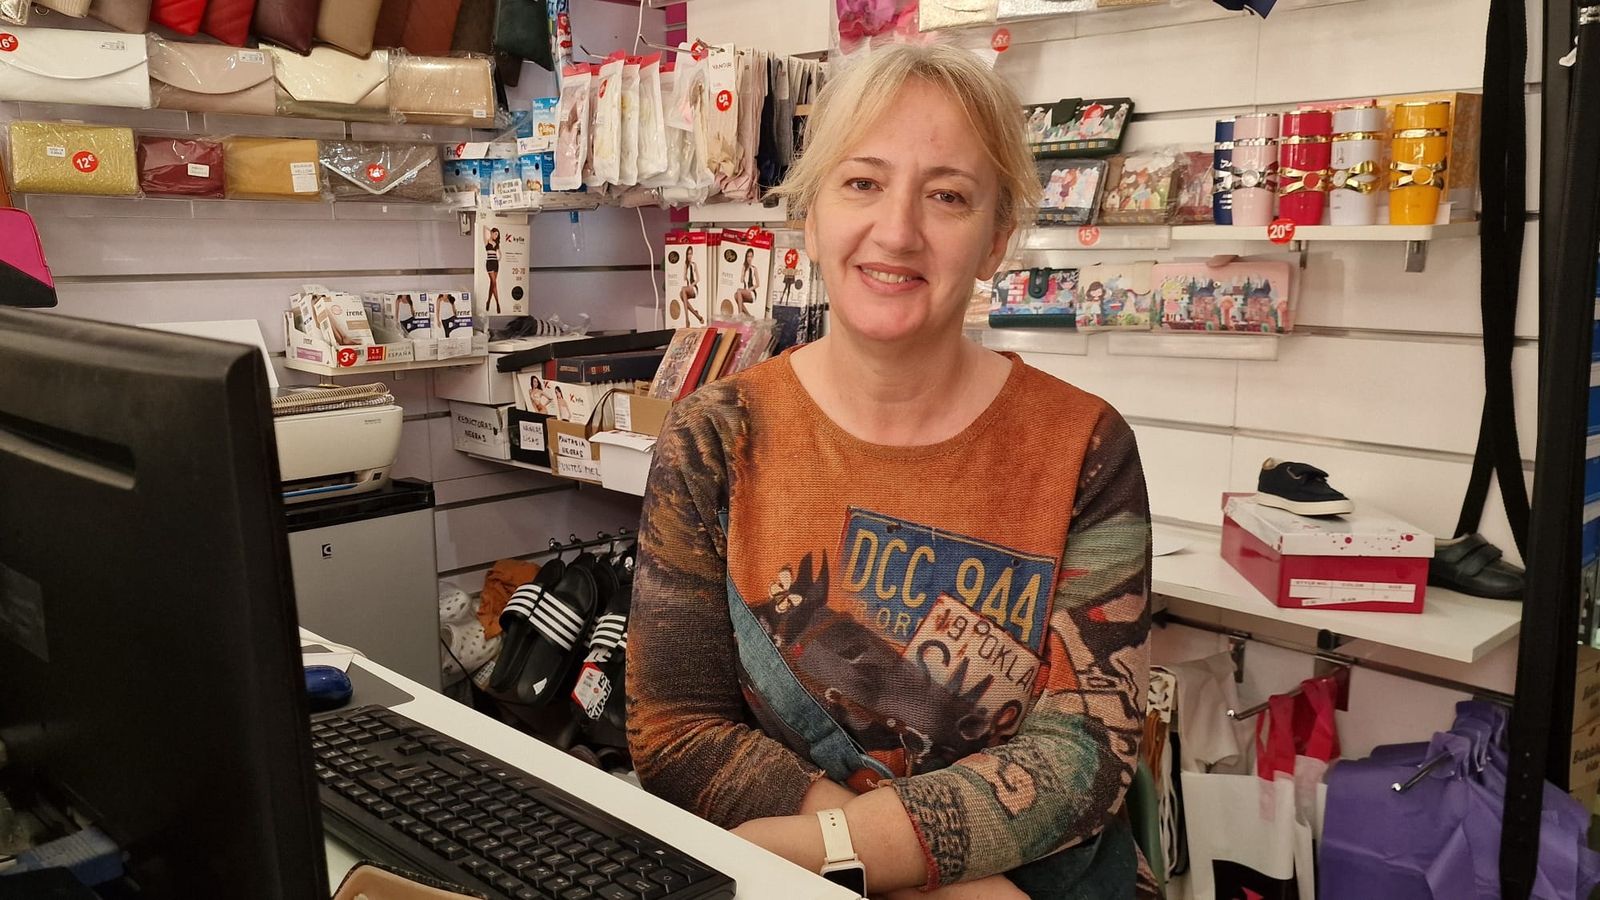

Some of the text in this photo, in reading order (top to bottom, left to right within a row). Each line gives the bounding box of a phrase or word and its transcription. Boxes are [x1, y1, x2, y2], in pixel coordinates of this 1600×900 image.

[76, 154, 95, 169] 12€
[748, 229, 759, 240] 5€
[1080, 225, 1098, 240] 15€
[1269, 223, 1293, 239] 20€
[786, 253, 797, 264] 3€
[346, 308, 363, 317] irene
[341, 352, 355, 363] 3€
[843, 529, 1041, 643] DCC 944
